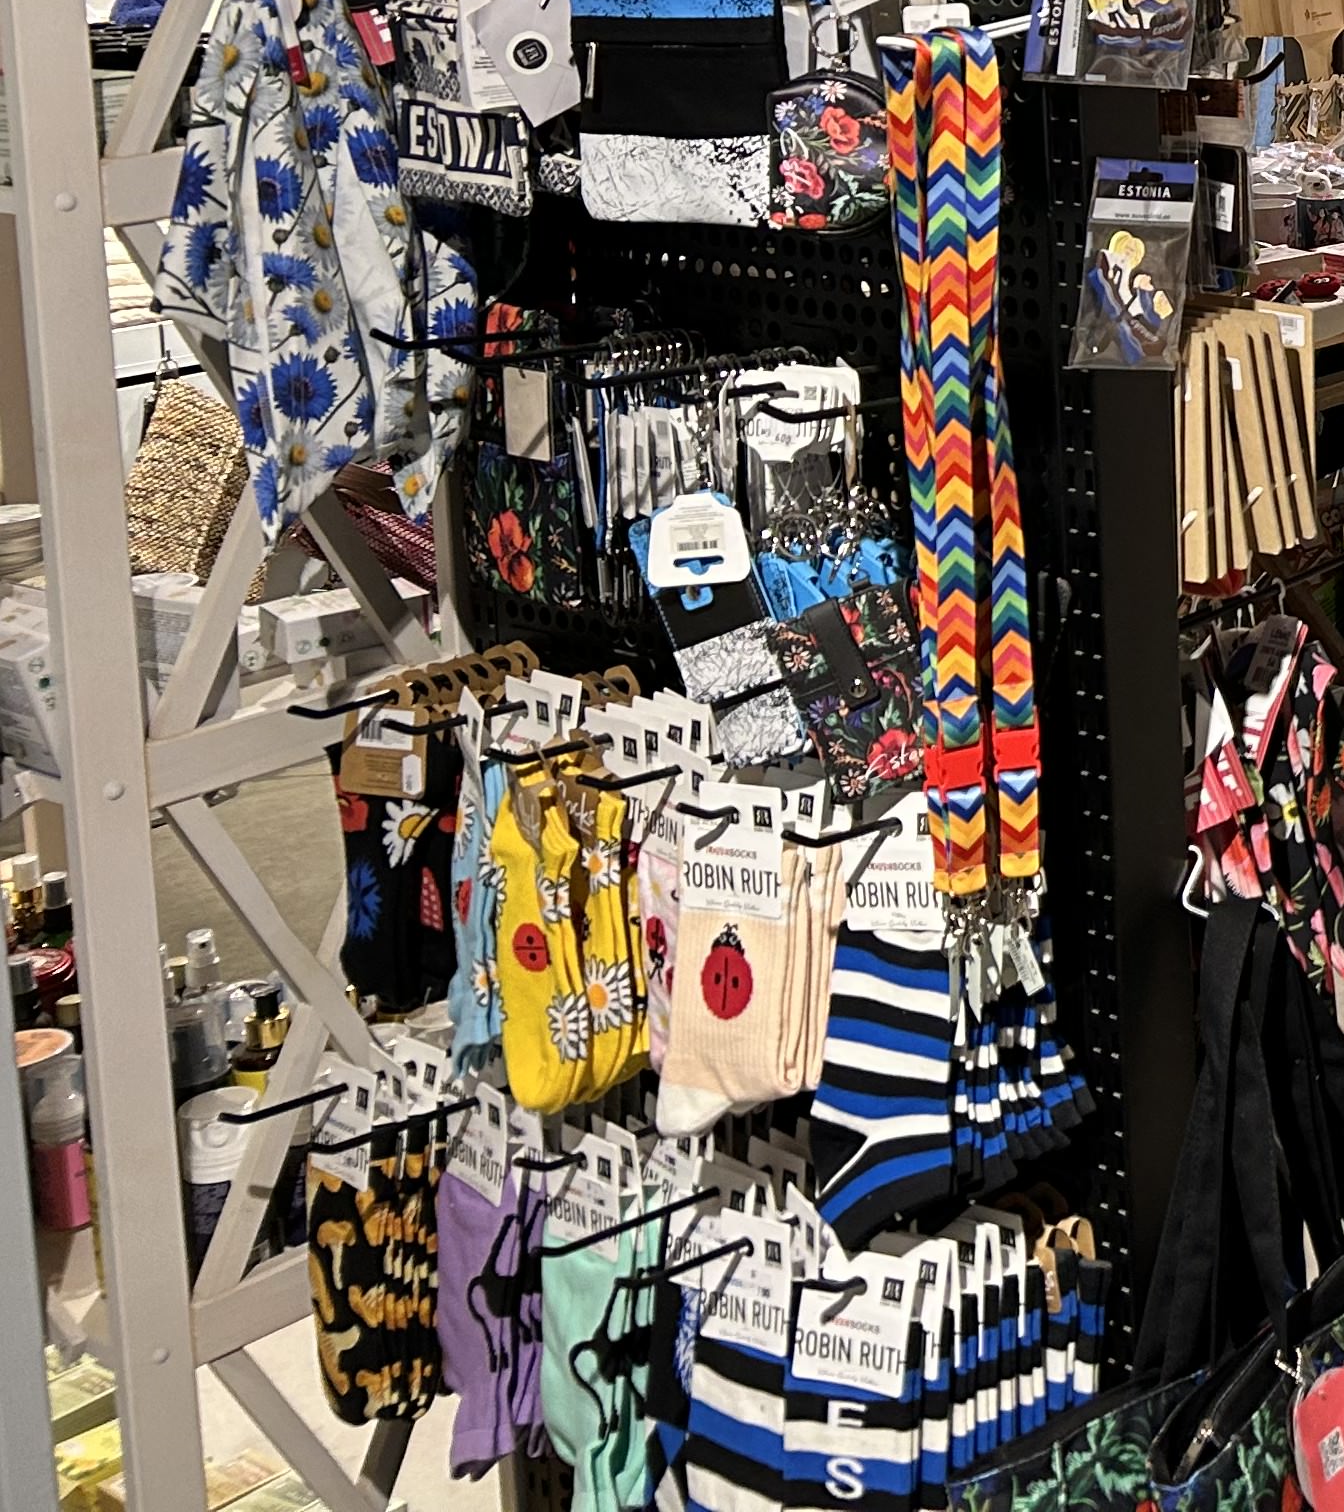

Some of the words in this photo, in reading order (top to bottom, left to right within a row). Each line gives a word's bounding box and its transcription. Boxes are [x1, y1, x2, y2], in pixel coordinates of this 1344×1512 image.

[1118, 183, 1172, 199] ESTONIA
[648, 805, 678, 846] OBIN
[683, 860, 735, 892] ROBIN
[740, 867, 782, 899] RUTH
[848, 879, 899, 909] ROBIN
[906, 880, 939, 909] RUT
[701, 1287, 746, 1326] ROBIN
[751, 1299, 790, 1337] RUTH
[795, 1327, 851, 1362] ROBIN
[858, 1339, 906, 1376] RUTH
